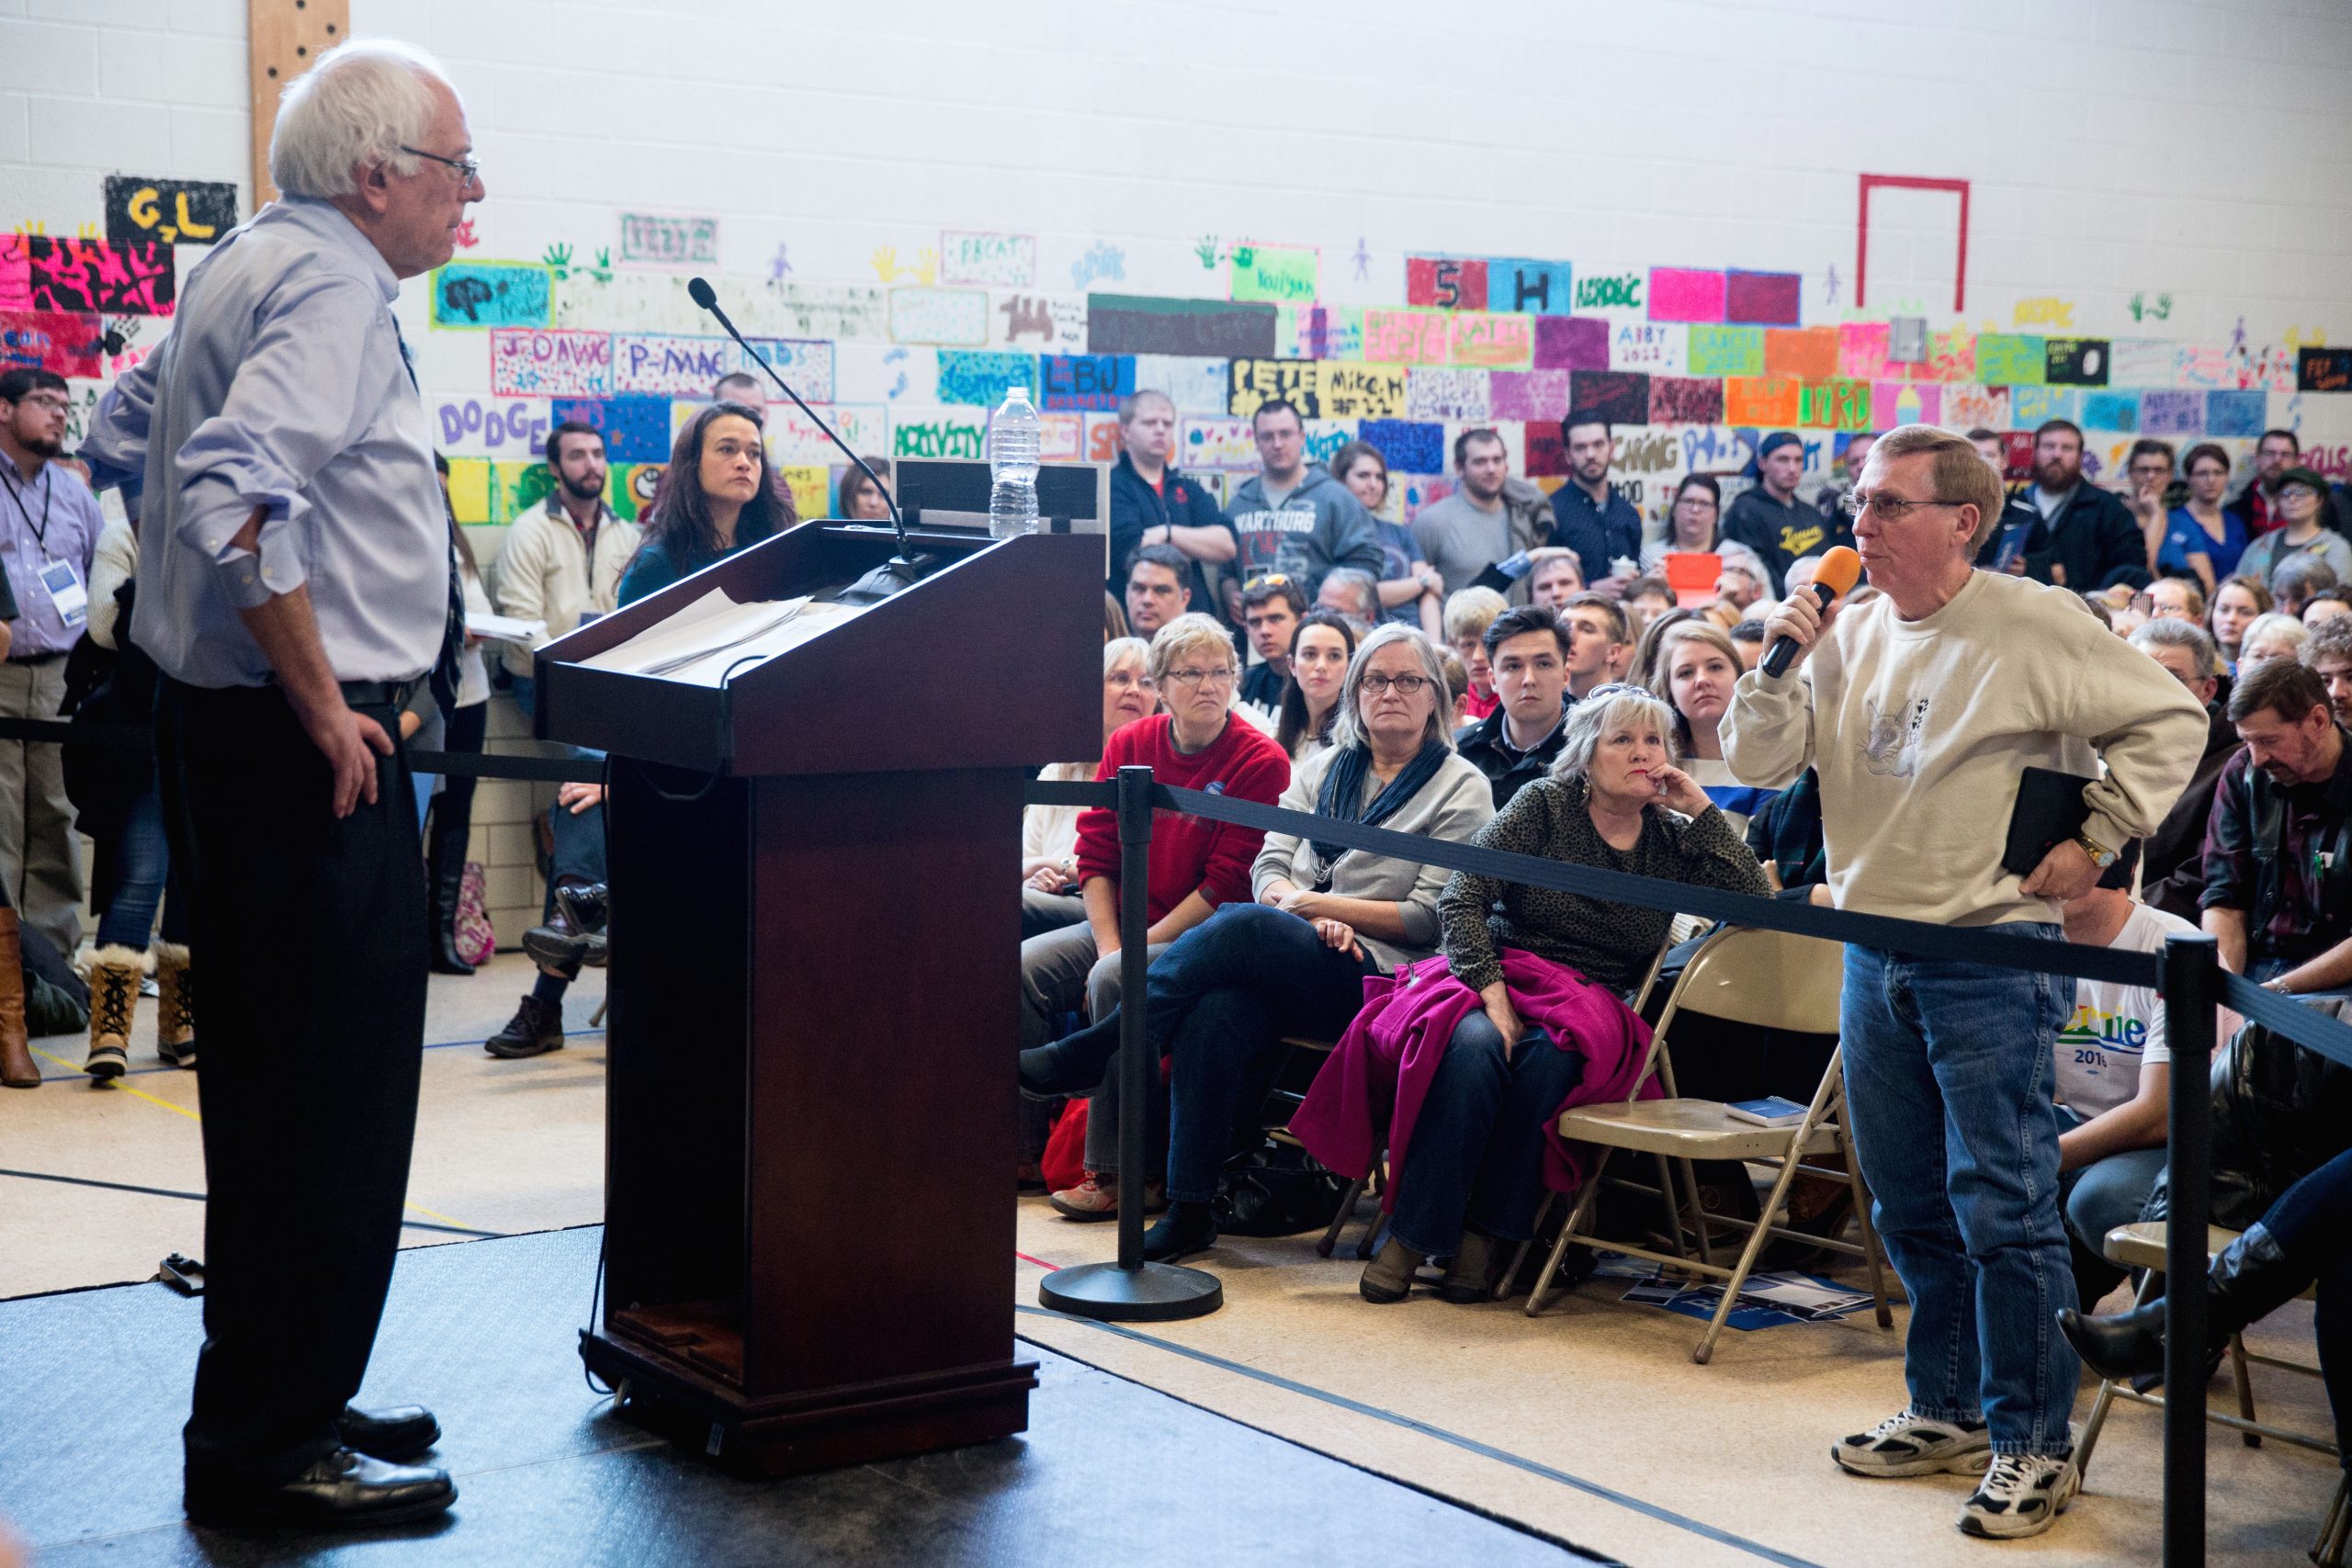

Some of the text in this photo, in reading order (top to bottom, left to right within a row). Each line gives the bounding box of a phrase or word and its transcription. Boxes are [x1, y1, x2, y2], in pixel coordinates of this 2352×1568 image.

[1515, 268, 1549, 312] H
[1234, 359, 1317, 393] PETE
[438, 399, 548, 456] DODGE
[893, 420, 987, 458] ACTIVITY
[2074, 1049, 2108, 1068] 2016
